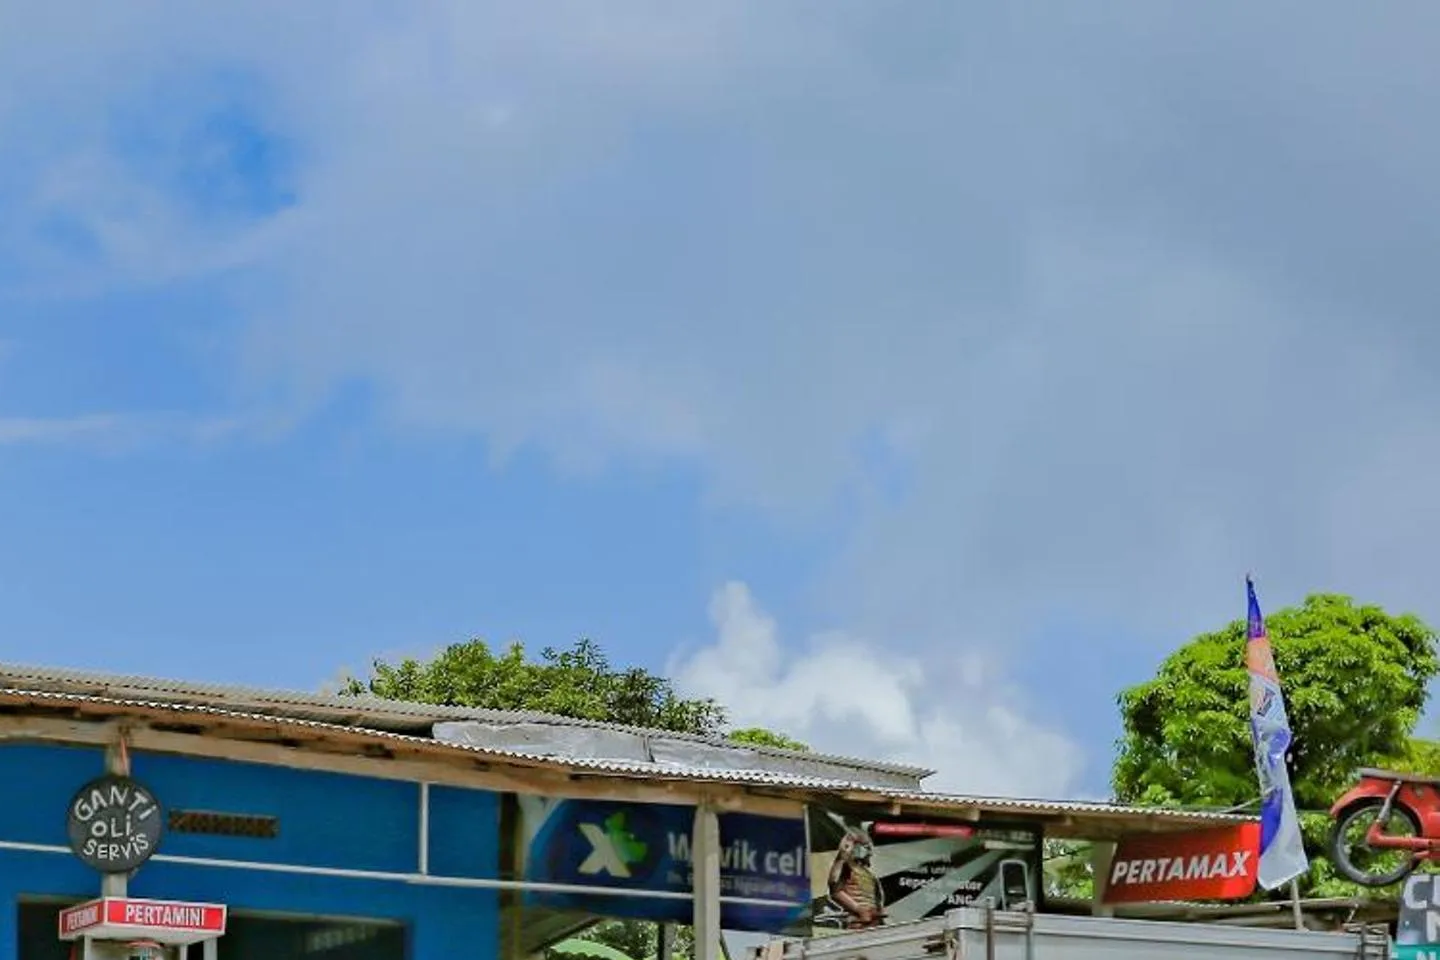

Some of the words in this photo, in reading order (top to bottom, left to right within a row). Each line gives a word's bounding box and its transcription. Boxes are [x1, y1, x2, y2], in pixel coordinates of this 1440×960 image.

[74, 785, 157, 822] GANTI
[1111, 850, 1251, 885] PERTAMAX
[125, 904, 205, 926] PERTAMINI
